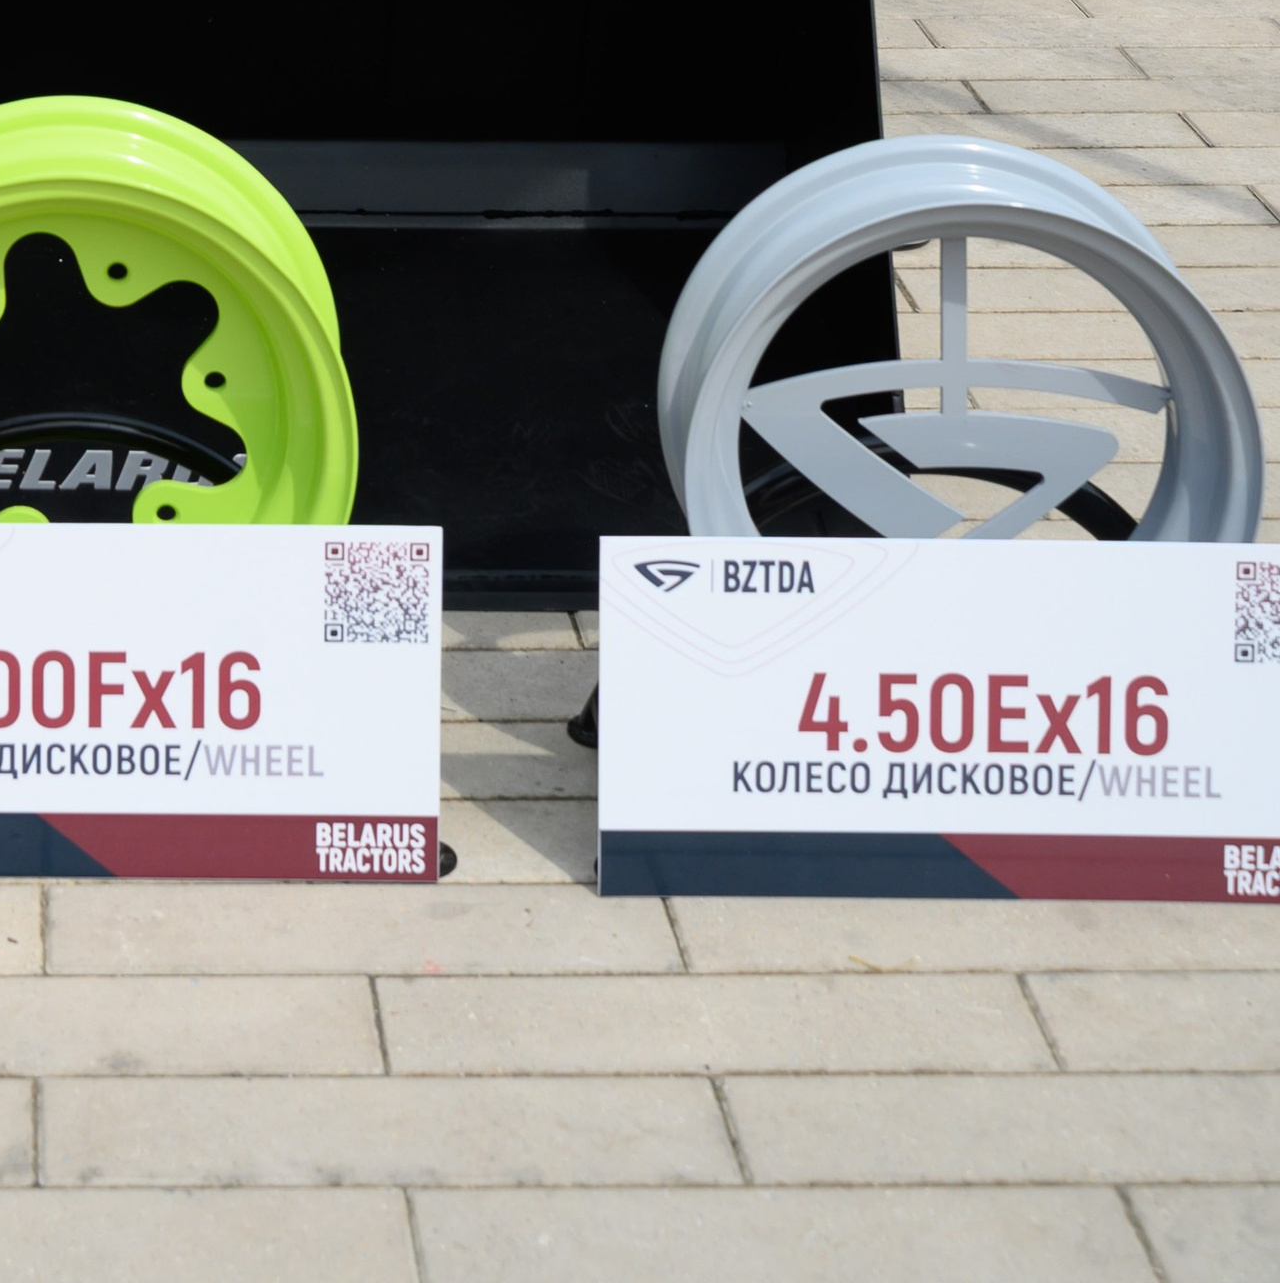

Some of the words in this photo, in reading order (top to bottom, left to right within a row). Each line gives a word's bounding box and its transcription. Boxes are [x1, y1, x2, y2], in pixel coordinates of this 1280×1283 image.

[723, 560, 815, 593] BZTDA
[799, 672, 1169, 756] 4.50Ex16
[732, 760, 871, 794] КОЛЕСО
[882, 759, 1221, 801] ДИСКОВОЕ/WHEEL
[315, 823, 425, 848] BELARUS
[316, 849, 426, 874] TRACTORS
